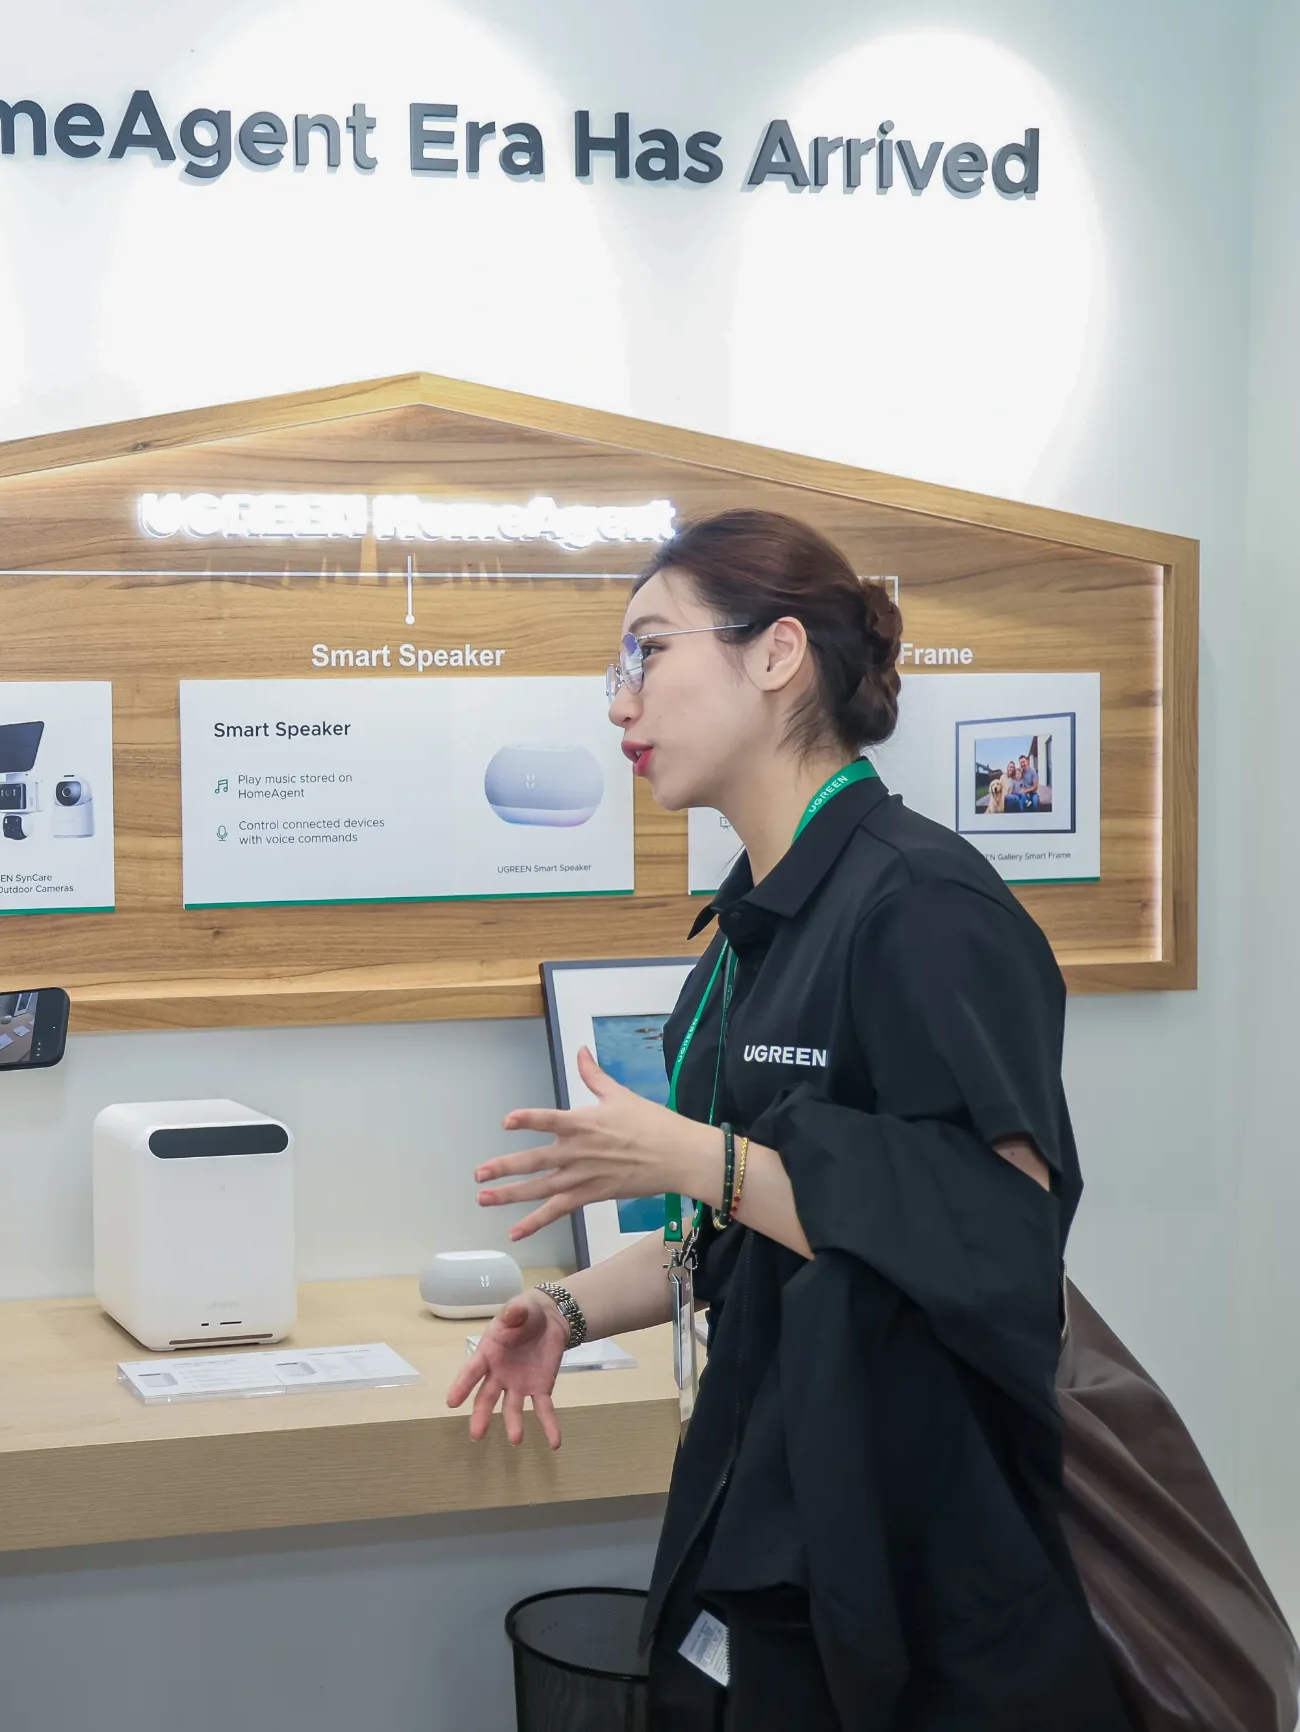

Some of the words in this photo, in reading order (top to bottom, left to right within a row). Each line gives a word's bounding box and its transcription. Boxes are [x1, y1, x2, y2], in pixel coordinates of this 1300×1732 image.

[410, 103, 544, 176] Era
[574, 110, 724, 184] Has
[747, 118, 1040, 195] Arrived
[311, 643, 391, 668] Smart
[398, 642, 506, 672] Speaker
[899, 642, 973, 665] Frame
[213, 721, 270, 738] Smart
[275, 720, 351, 740] Speaker
[238, 774, 261, 786] Play
[265, 773, 297, 784] music
[300, 772, 335, 783] stored
[338, 774, 353, 783] on
[238, 788, 305, 800] HomeAgent
[808, 775, 848, 813] UGREEN
[238, 819, 279, 831] Control
[282, 818, 341, 829] connected
[343, 817, 385, 828] devices
[239, 833, 262, 844] with
[265, 833, 295, 844] voice
[298, 832, 358, 843] commands
[997, 852, 1023, 863] Gallery
[1024, 852, 1047, 861] Smart
[1048, 851, 1072, 860] Frame
[497, 864, 532, 874] UGREEN
[533, 864, 558, 873] Smart
[559, 863, 592, 873] Speaker
[15, 873, 53, 884] SynCare
[35, 884, 74, 893] Cameras
[742, 1044, 828, 1068] UGREEN
